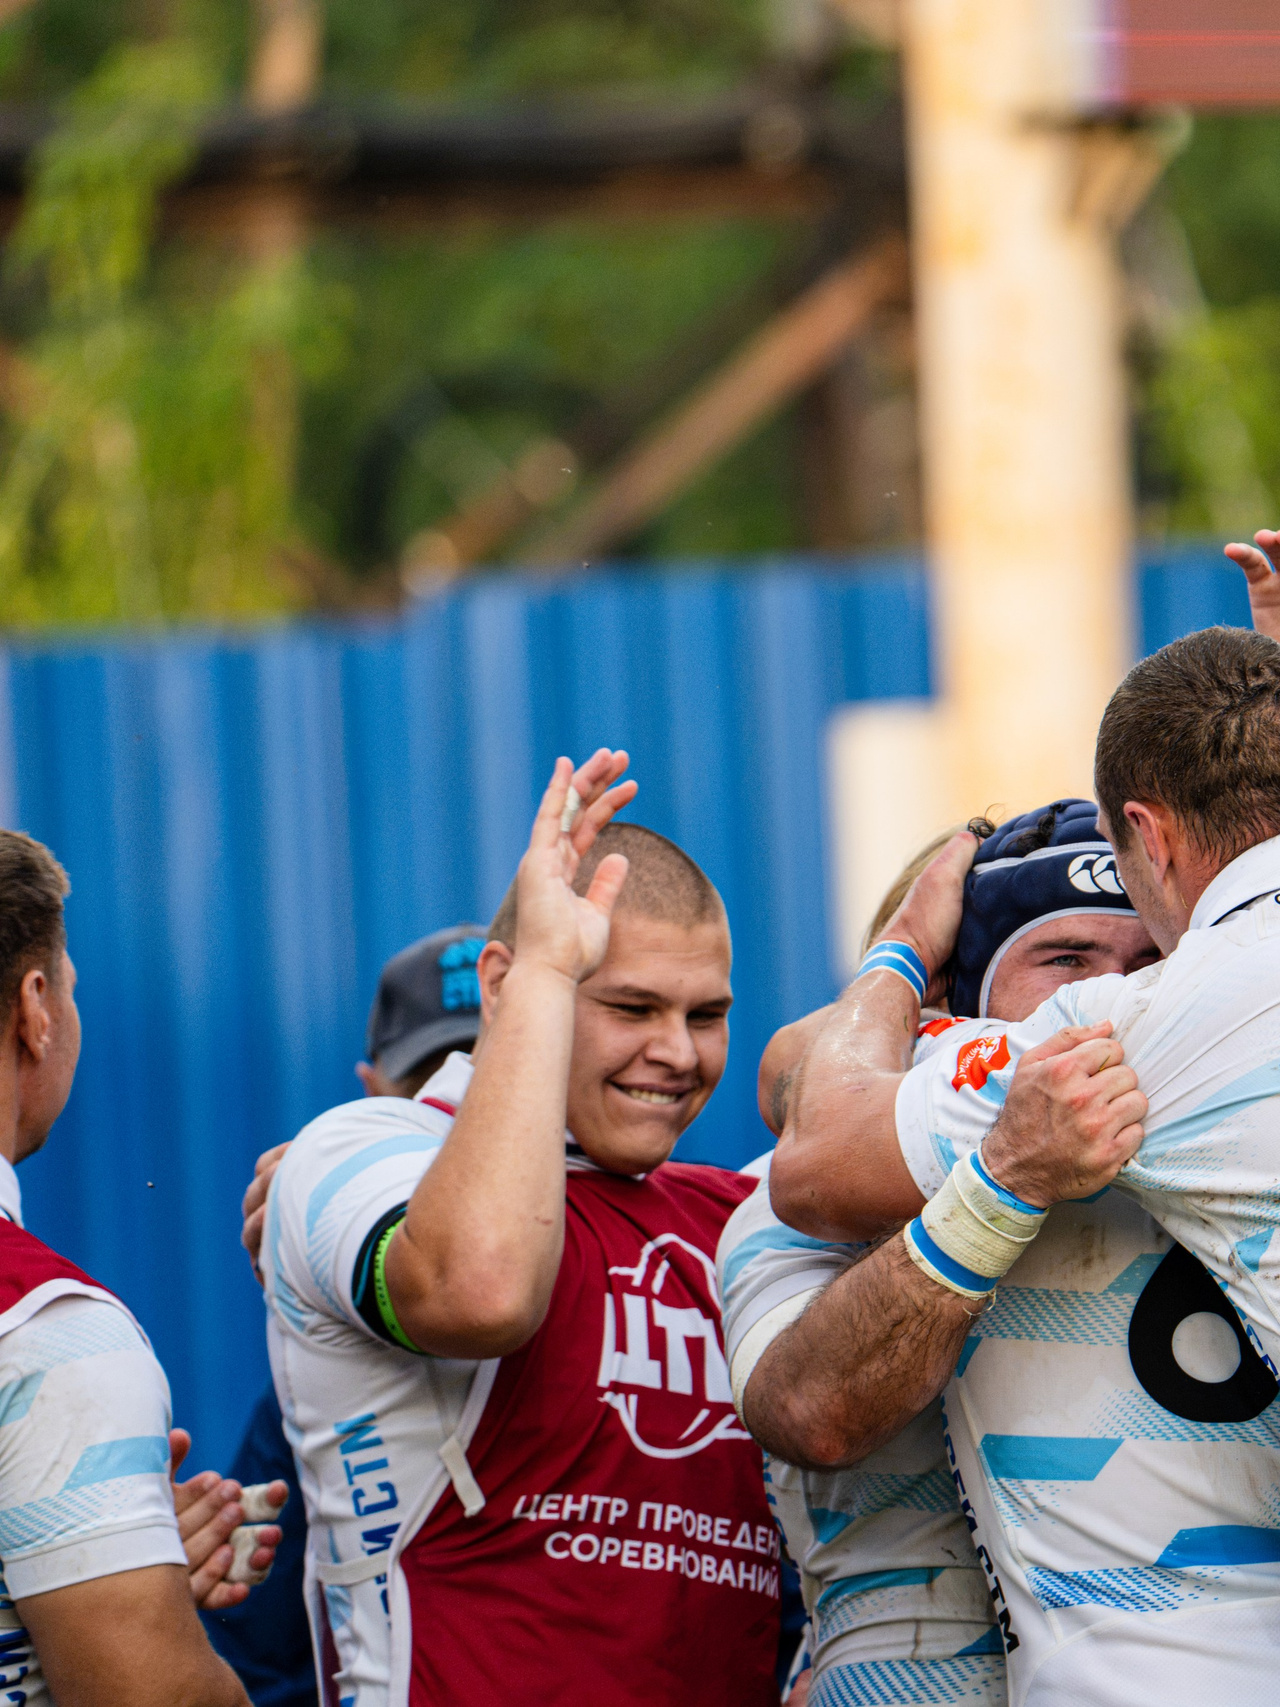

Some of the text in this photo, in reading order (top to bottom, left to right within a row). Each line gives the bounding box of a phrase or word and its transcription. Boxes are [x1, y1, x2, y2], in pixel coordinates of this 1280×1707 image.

[333, 1411, 399, 1518] СТМ
[512, 1493, 629, 1526] ЦЕНТР
[544, 1531, 780, 1600] СОРЕВНОВАНИЙ
